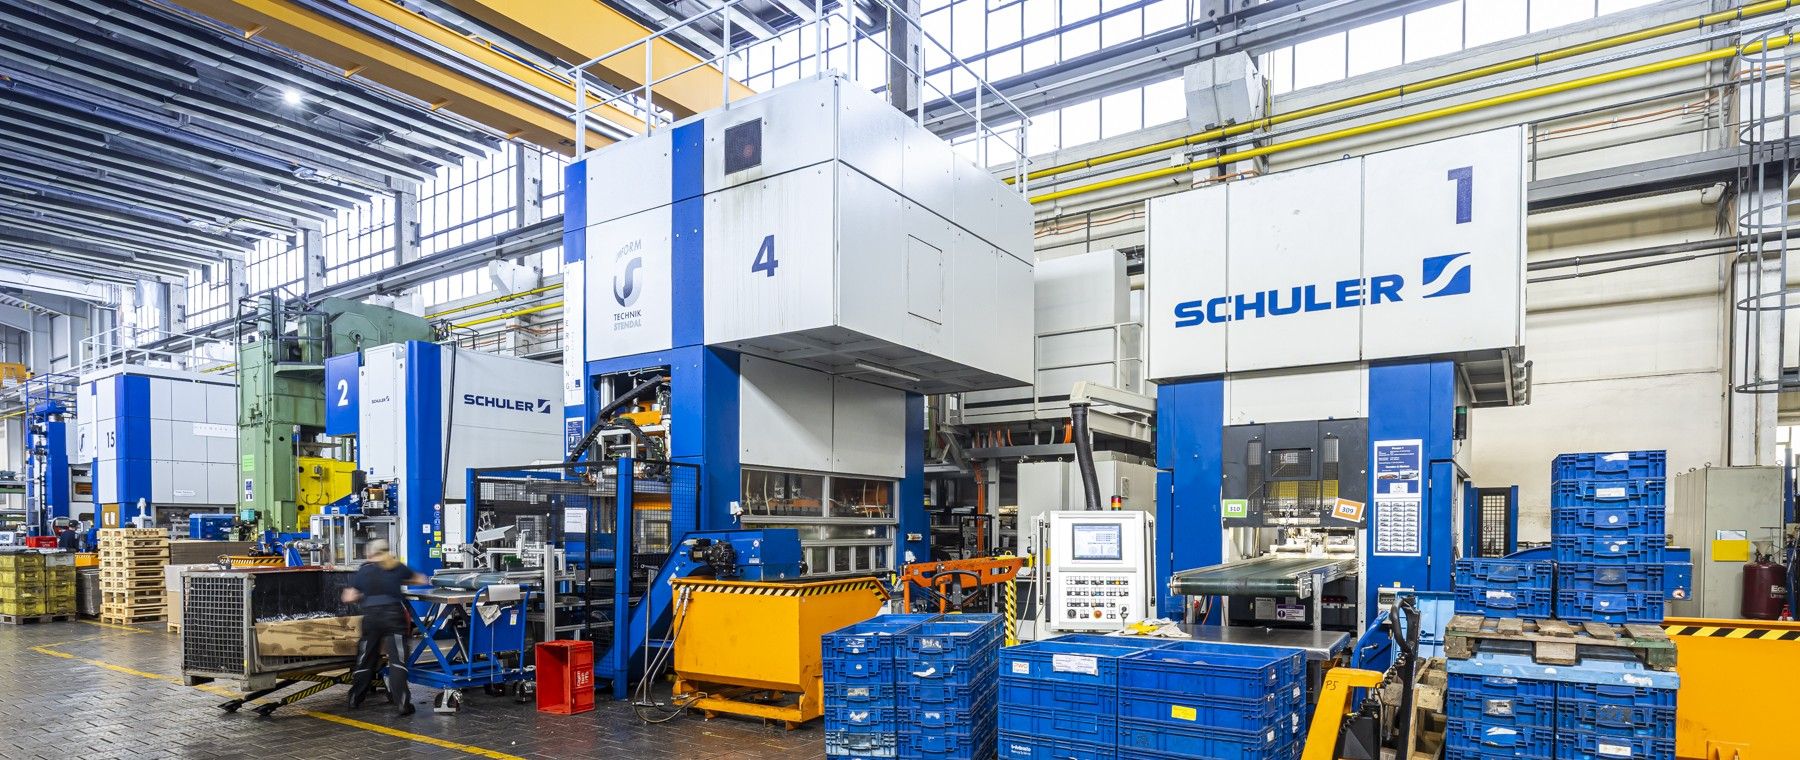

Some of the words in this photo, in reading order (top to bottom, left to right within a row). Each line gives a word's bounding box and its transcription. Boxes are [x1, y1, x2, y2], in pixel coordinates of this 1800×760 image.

[1447, 166, 1473, 225] 1
[751, 234, 779, 278] 4
[1173, 273, 1405, 328] SCHULER
[613, 309, 642, 321] TECHNIK
[613, 319, 642, 332] STENDAL
[337, 379, 349, 407] 2
[463, 393, 534, 412] SCHULER
[106, 432, 115, 448] 15
[1341, 506, 1354, 514] 309
